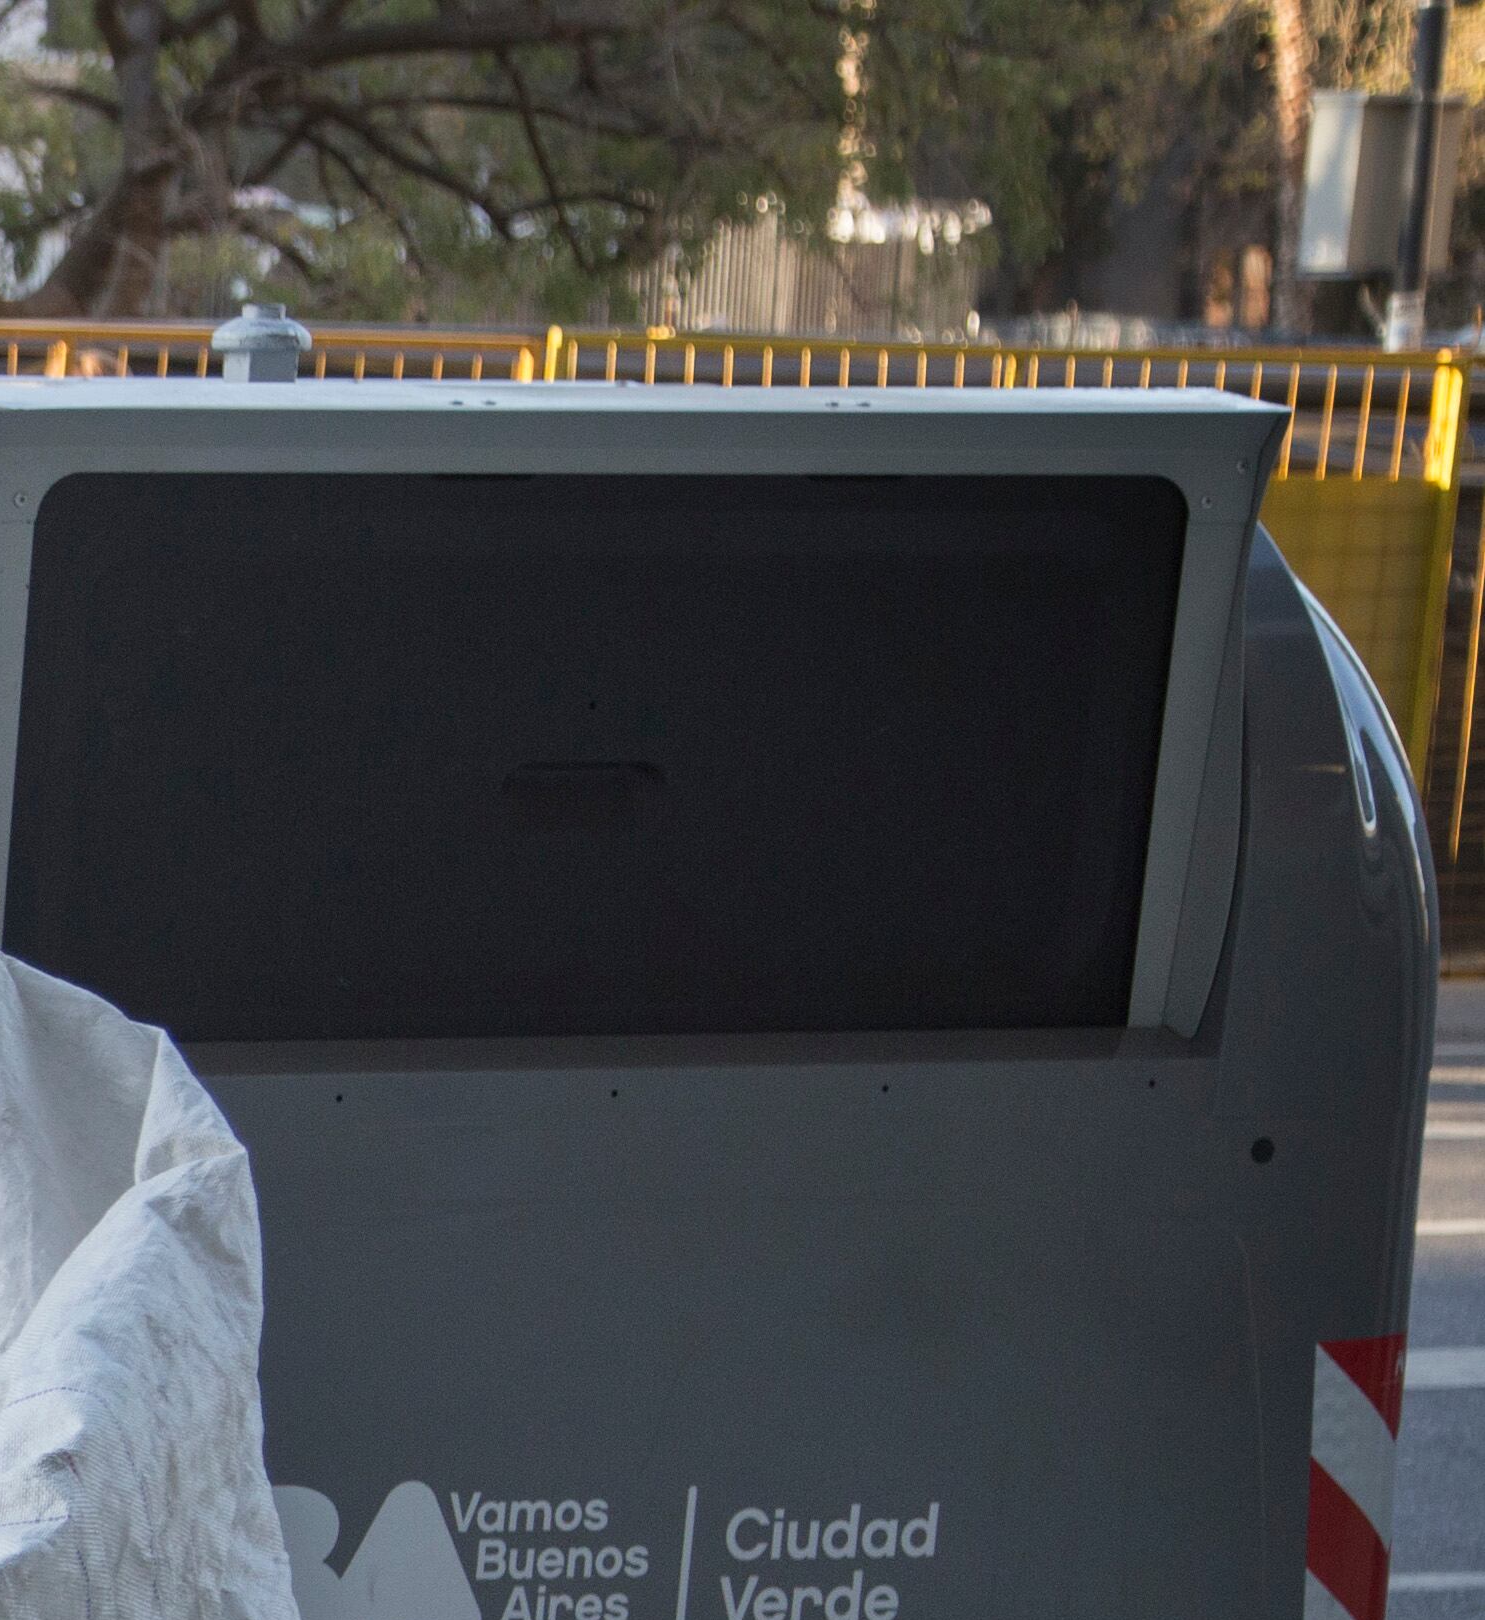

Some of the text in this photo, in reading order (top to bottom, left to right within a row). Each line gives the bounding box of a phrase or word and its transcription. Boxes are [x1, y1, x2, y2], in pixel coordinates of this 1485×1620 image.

[450, 1491, 609, 1533] Vamos
[725, 1502, 940, 1561] Ciudad
[475, 1540, 649, 1581] Buenos
